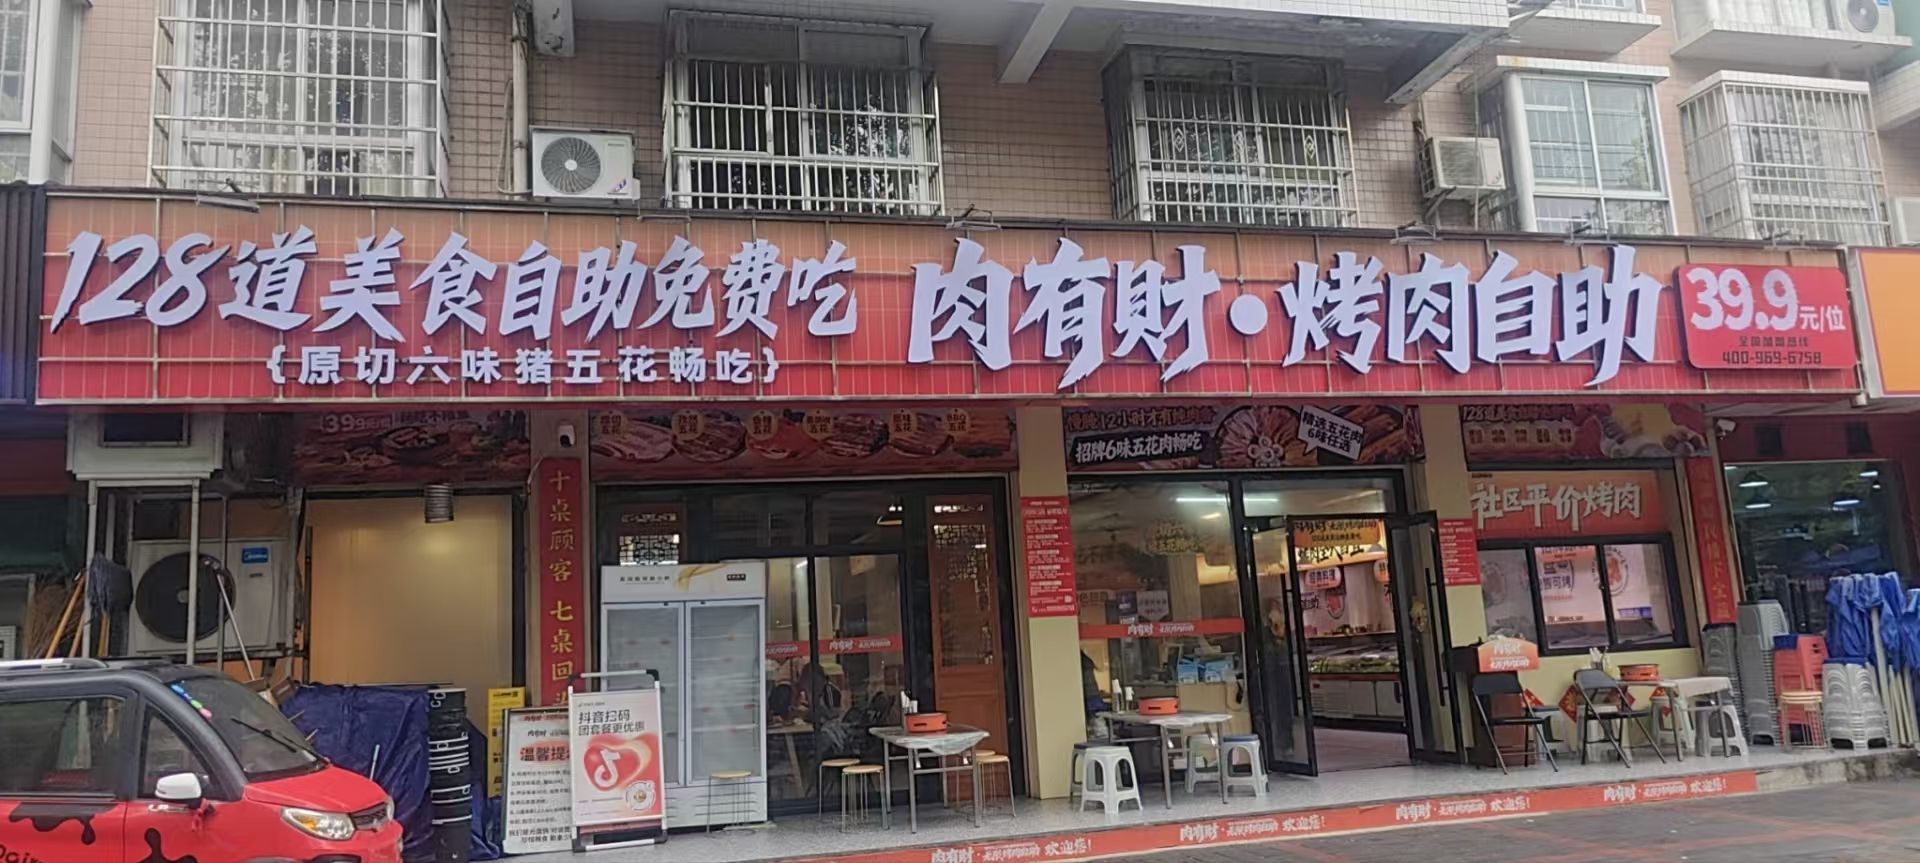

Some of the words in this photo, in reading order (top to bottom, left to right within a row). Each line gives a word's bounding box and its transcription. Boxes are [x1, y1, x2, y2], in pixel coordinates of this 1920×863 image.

[51, 224, 858, 343] 128道美食自助免费吃
[1722, 351, 1822, 364] 400-969-6758
[1302, 411, 1361, 444] 精选五花肉
[1307, 427, 1351, 453] 6味任选
[1075, 431, 1203, 464] 招牌6味五花肉畅吃
[1471, 482, 1642, 532] 社区平价烤肉
[549, 470, 575, 582] 十桌顾客
[578, 709, 630, 724] 抖音扫码
[578, 721, 645, 736] 团套餐更优惠
